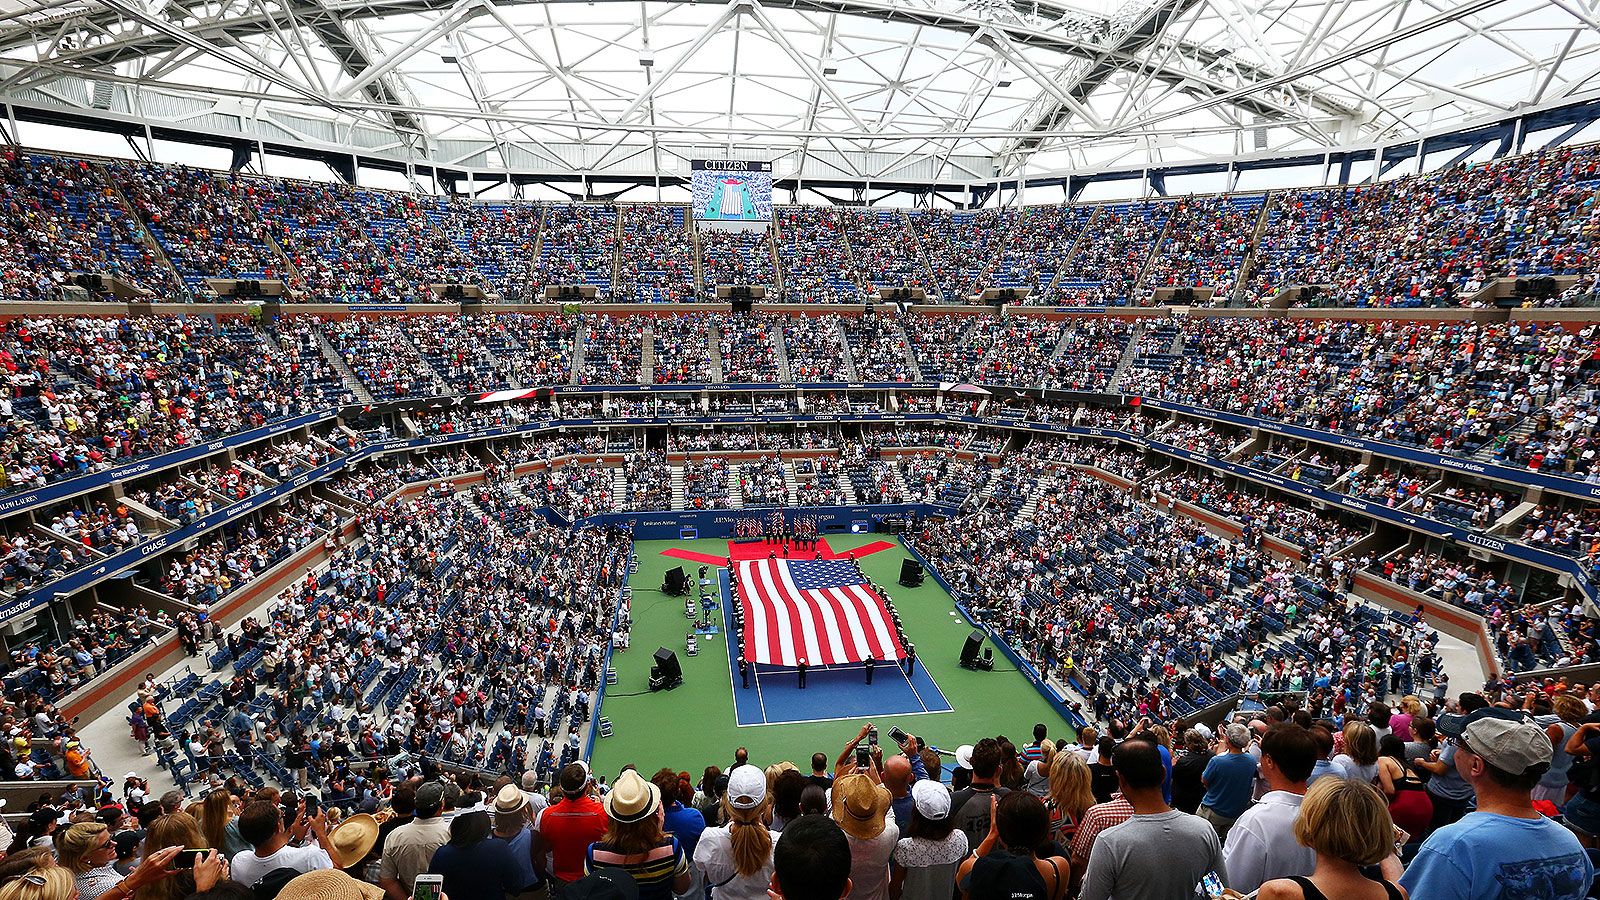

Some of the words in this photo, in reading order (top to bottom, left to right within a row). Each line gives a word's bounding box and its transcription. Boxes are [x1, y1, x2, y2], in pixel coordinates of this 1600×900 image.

[704, 161, 749, 170] CITIZEN
[1440, 457, 1464, 469] Emirates
[1464, 463, 1486, 472] Airline
[141, 538, 167, 555] CHASE
[1467, 534, 1505, 550] CITIZEN
